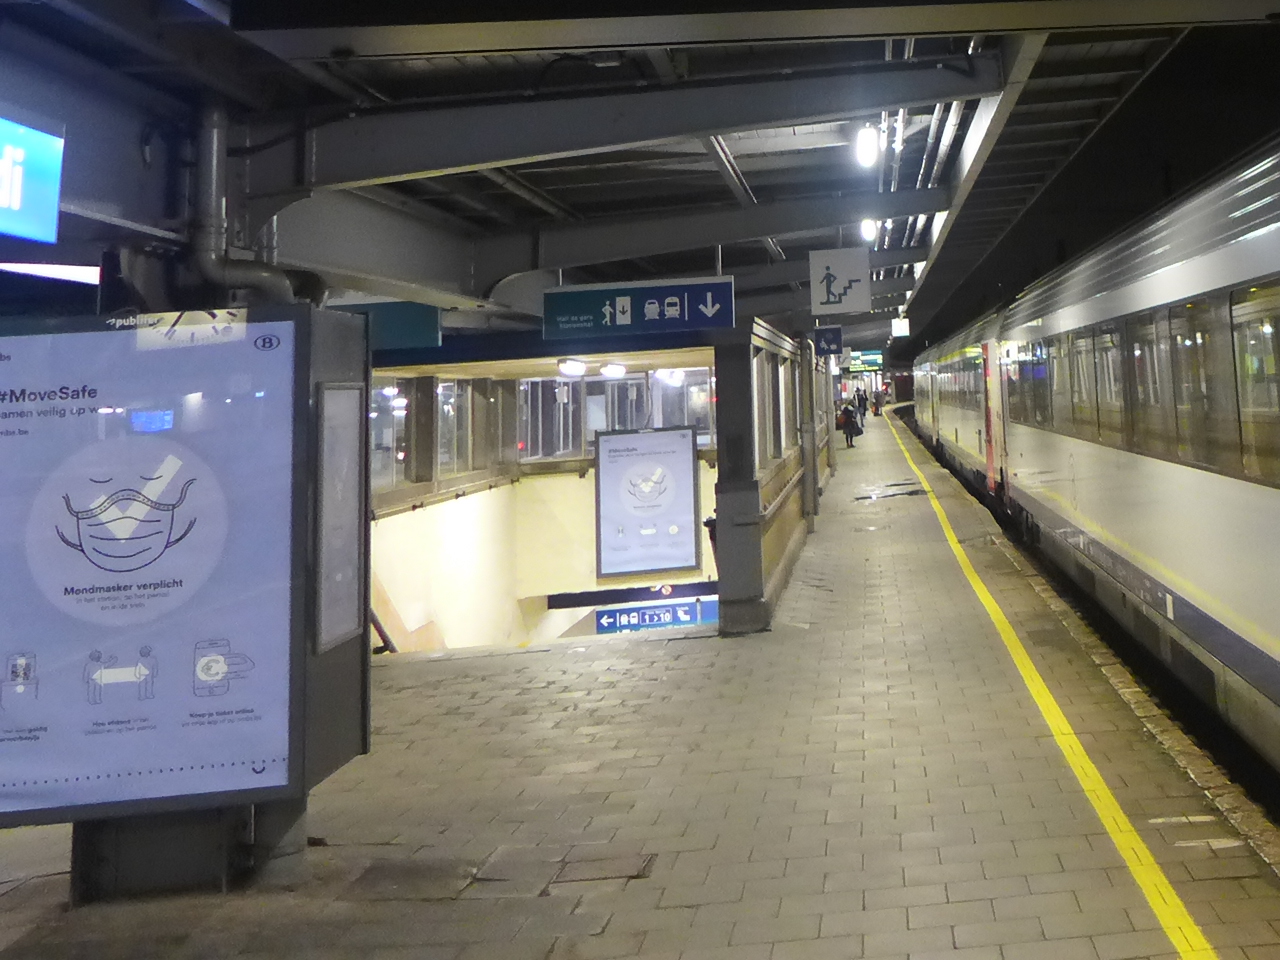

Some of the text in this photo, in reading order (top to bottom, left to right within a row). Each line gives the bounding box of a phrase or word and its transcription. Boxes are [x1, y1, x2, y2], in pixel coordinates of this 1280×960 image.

[0, 384, 98, 404] #MoveSafe
[0, 408, 33, 420] amen
[63, 578, 184, 596] Mondmasker verplicht
